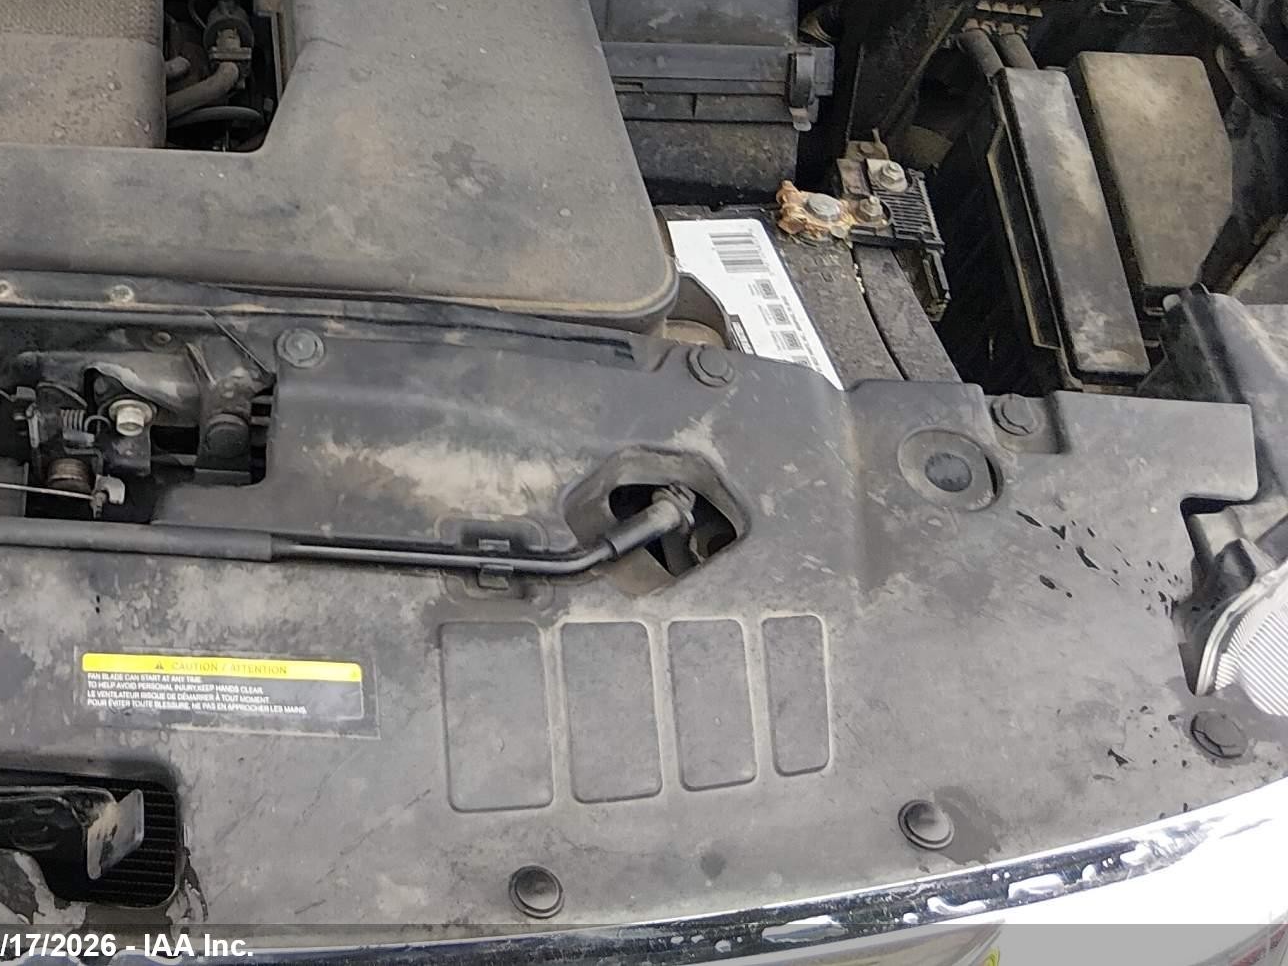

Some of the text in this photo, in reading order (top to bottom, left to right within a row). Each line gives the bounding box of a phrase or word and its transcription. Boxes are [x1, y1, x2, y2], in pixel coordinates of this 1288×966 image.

[172, 661, 219, 672] CAUTION
[230, 663, 287, 675] ATTENTION
[87, 672, 101, 680] FAN
[124, 673, 139, 681] CAN
[140, 674, 161, 682] START
[88, 680, 97, 688] TO
[98, 681, 116, 689] HELP
[138, 682, 173, 691] PERSONAL
[215, 684, 239, 693] HANDS
[96, 690, 140, 699] VENTILATEUR
[141, 691, 165, 700] RISQUE
[166, 692, 176, 700] DE
[177, 691, 214, 701] DÉMARRER
[222, 693, 239, 702] TOUT
[87, 699, 107, 707] POUR
[132, 700, 153, 708] TOUTE
[192, 702, 202, 710] NE
[202, 702, 216, 710] PAS
[217, 702, 226, 711] EN
[270, 705, 282, 713] LES
